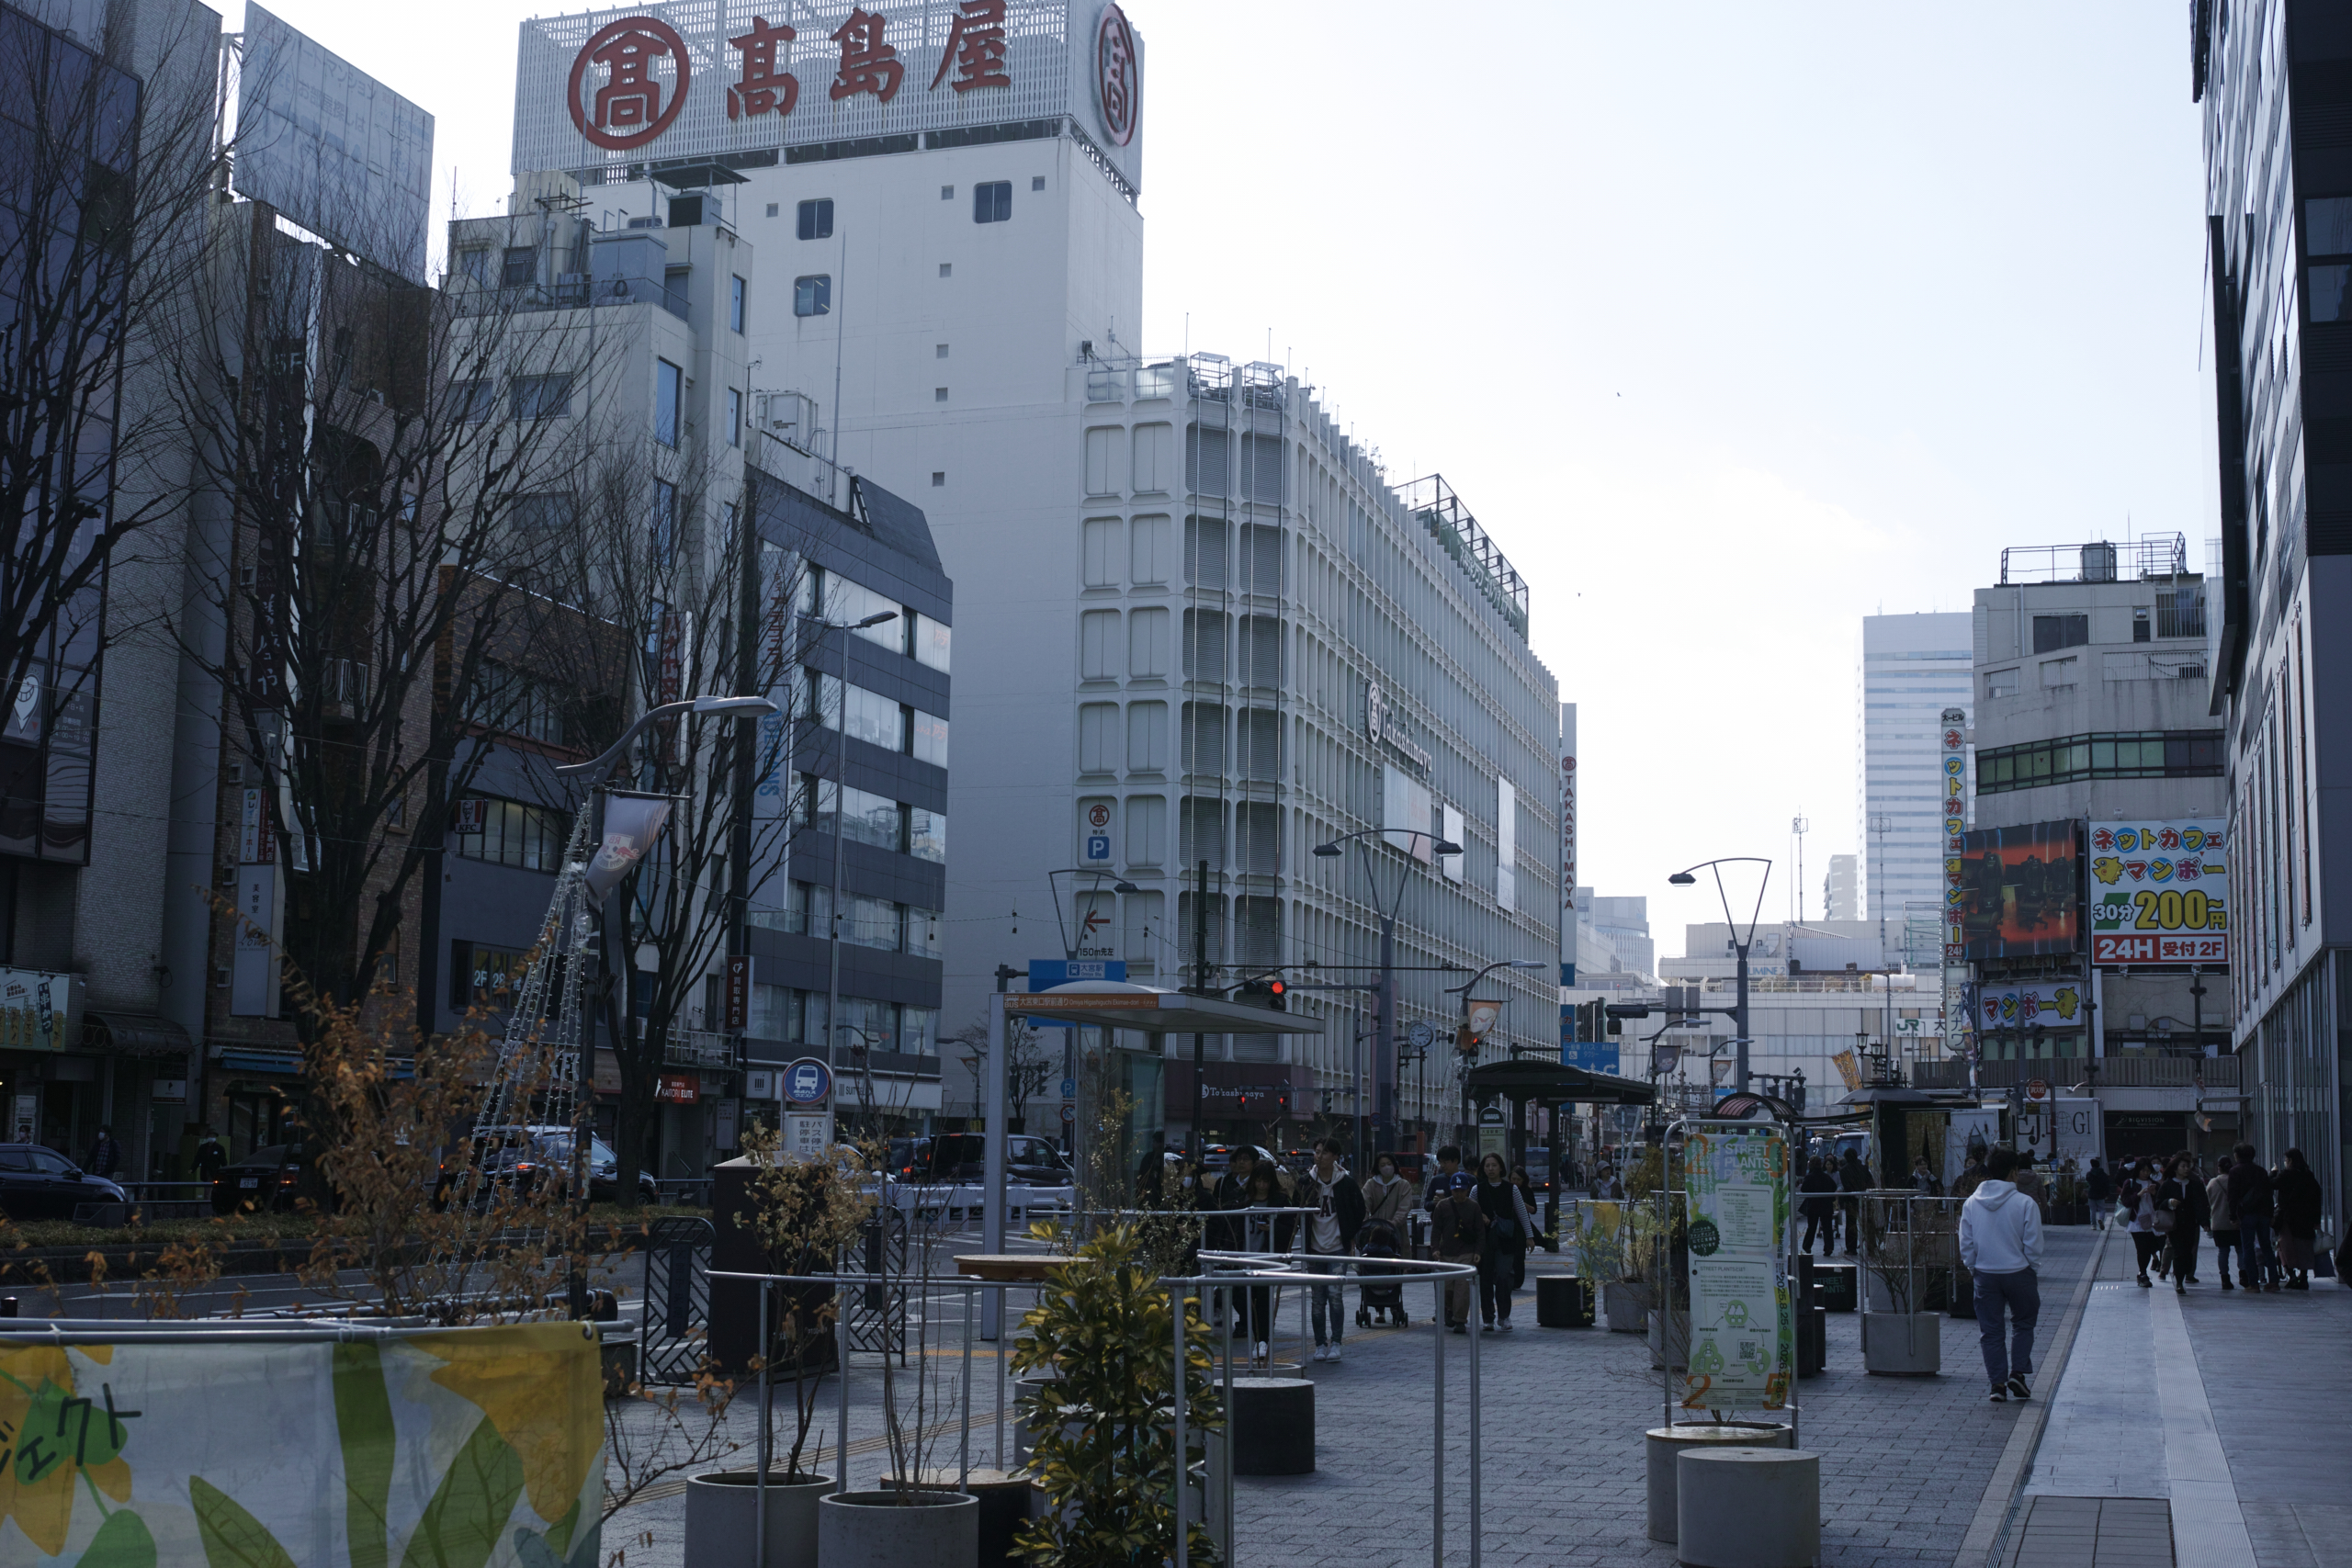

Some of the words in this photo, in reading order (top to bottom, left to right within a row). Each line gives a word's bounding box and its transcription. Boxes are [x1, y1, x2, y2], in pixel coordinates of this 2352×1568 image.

[1944, 728, 1964, 852] ネットカフェ
[458, 824, 477, 832] KFC
[1564, 774, 1575, 910] TAKASHIMAYA
[2092, 828, 2224, 852] ネットカフェ
[1092, 840, 1105, 856] P
[2124, 856, 2226, 882] マンボー
[251, 884, 260, 914] 美容室
[2093, 903, 2134, 921] 30分
[1080, 947, 1114, 956] 150m先左
[2099, 939, 2154, 959] 24H
[2162, 942, 2196, 956] 受付
[2199, 942, 2222, 956] 2F
[1080, 964, 1103, 972] 大宮駅
[1749, 967, 1782, 977] UMINE
[1785, 967, 1791, 977] 2
[473, 970, 488, 987] 2F
[731, 976, 741, 1025] 買取専門店
[1020, 997, 1069, 1007] 大宮東口駅前通り
[1983, 991, 2055, 1021] マンボー
[40, 992, 52, 1030] 串かつ
[1896, 1019, 1919, 1032] JR
[2030, 1086, 2045, 1095] 消火栓
[1724, 1144, 1770, 1156] STREET
[1724, 1156, 1770, 1169] PLANTS
[1724, 1169, 1773, 1182] PROJECT
[1813, 1276, 1844, 1285] STREET
[1824, 1284, 1846, 1294] ANTS
